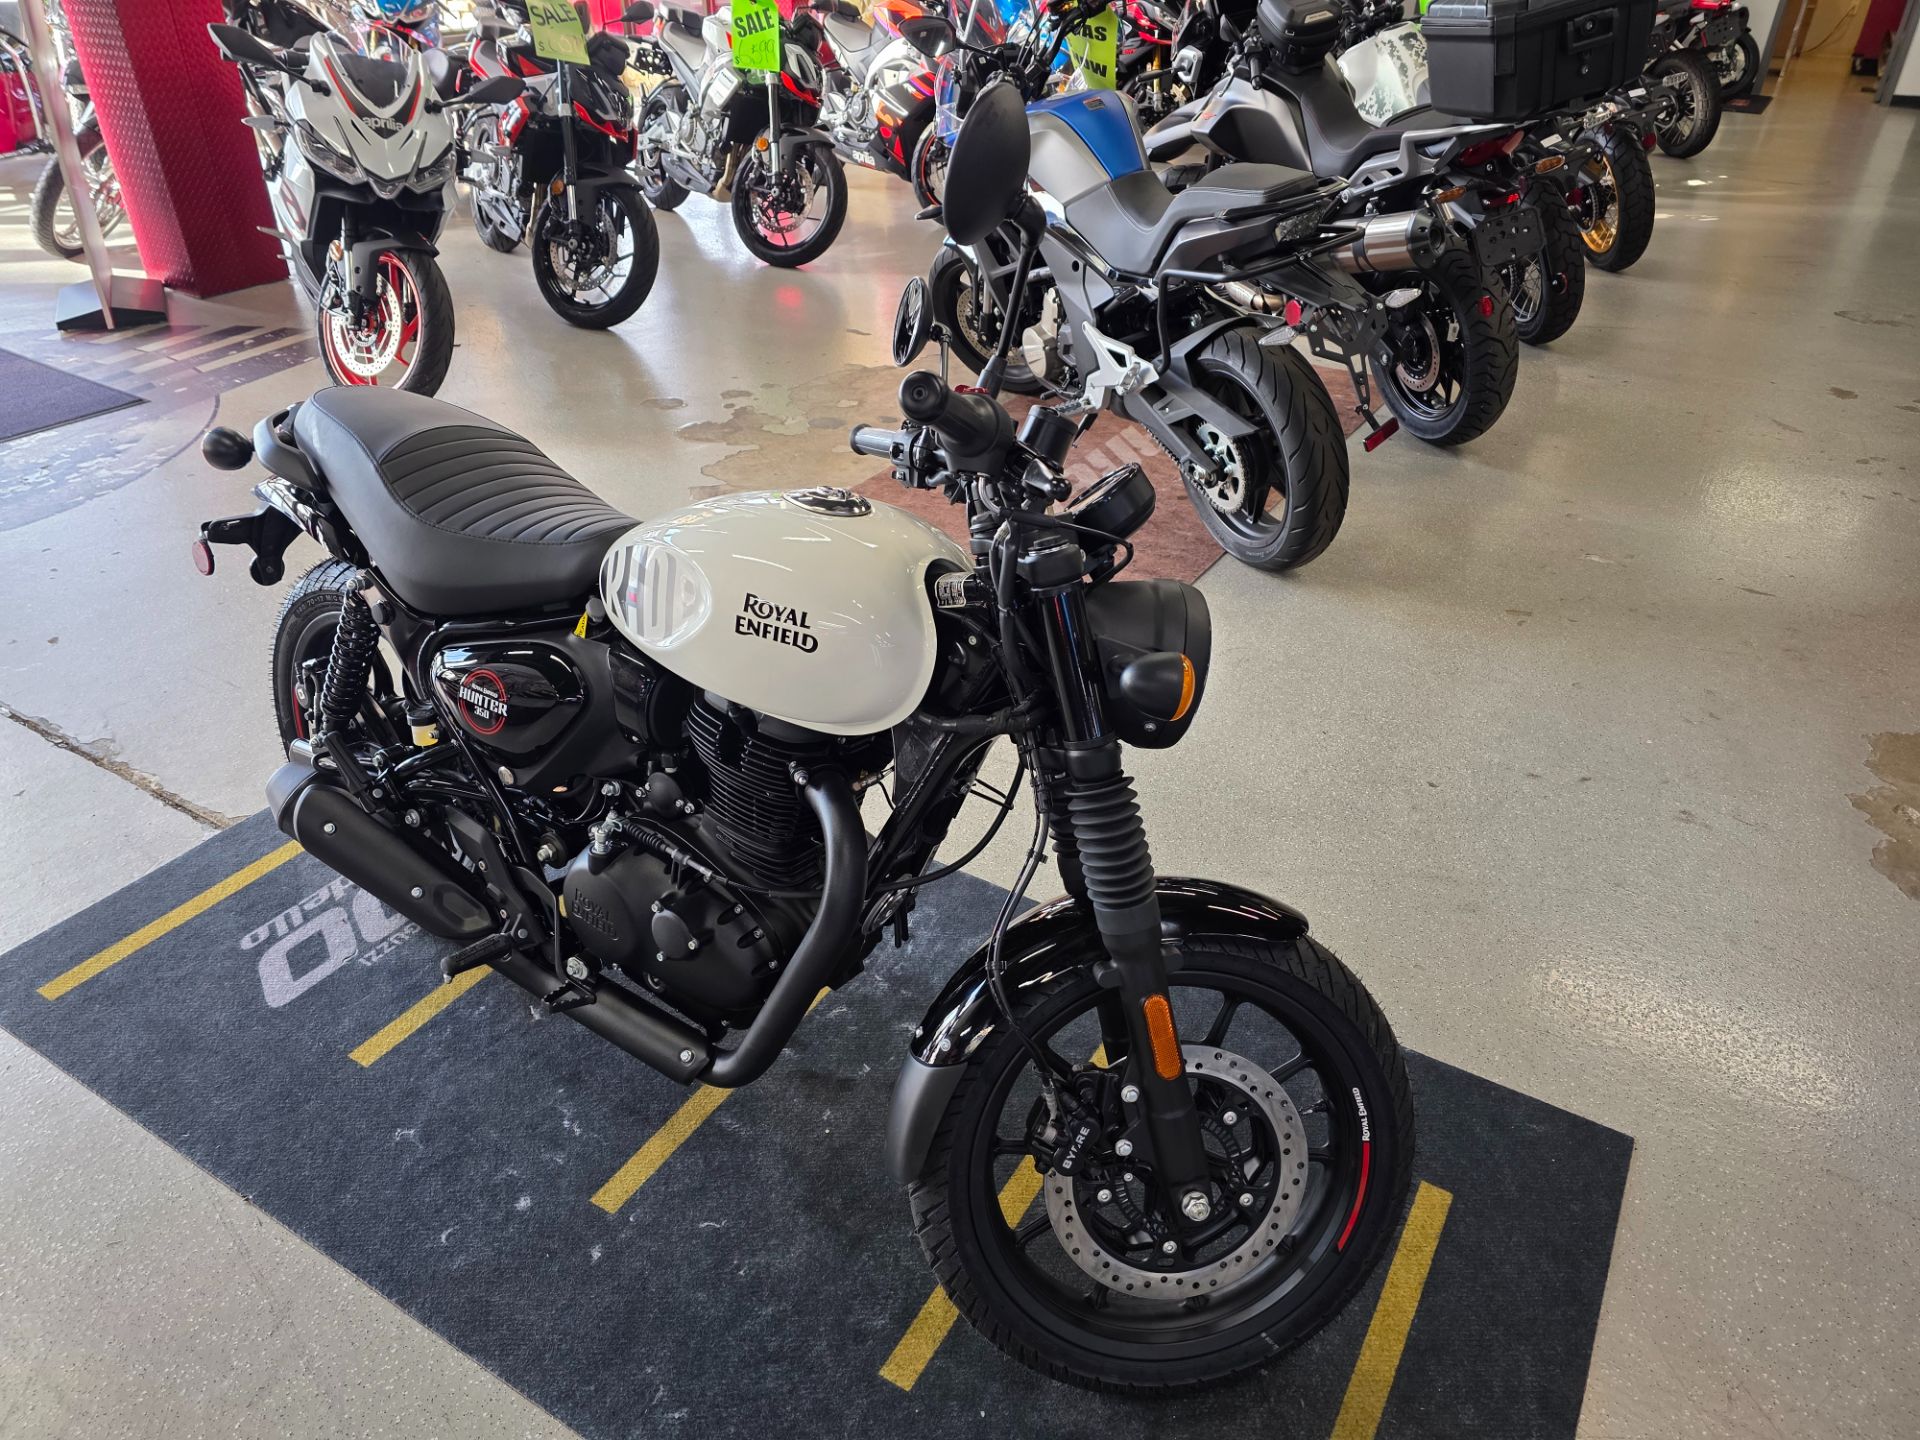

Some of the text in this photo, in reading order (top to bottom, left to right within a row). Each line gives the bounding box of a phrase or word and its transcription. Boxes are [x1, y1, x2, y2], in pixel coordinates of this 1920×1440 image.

[530, 4, 578, 26] SALE
[734, 7, 774, 38] SALE
[1073, 22, 1107, 42] AS
[362, 117, 403, 131] aprilia
[743, 592, 811, 630] ROYAL
[735, 614, 819, 654] ENFIELD
[460, 685, 508, 717] HUNTER
[474, 705, 490, 719] 350
[1352, 1086, 1371, 1142] ROYAL ENFIELD
